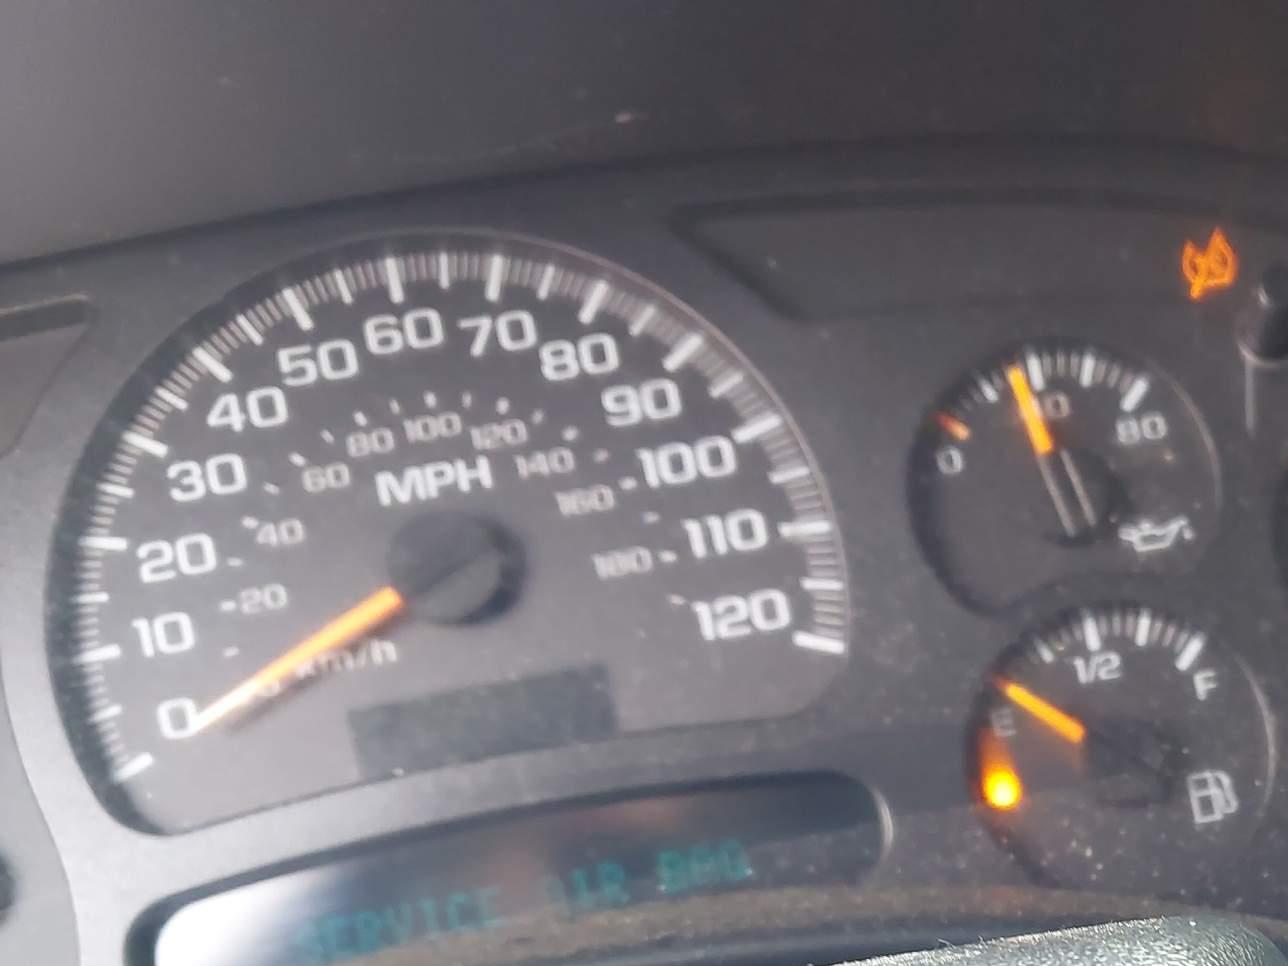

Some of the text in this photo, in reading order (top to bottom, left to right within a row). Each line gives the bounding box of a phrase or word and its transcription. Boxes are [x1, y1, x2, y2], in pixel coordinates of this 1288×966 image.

[363, 307, 445, 355] 60
[458, 309, 538, 357] 70
[277, 339, 359, 387] 50
[538, 332, 620, 382] 80
[206, 385, 289, 433] 40
[600, 377, 683, 427] 90
[347, 426, 395, 458] 80
[404, 411, 462, 443] 100
[470, 418, 528, 451] 120
[1115, 412, 1167, 446] 80
[166, 453, 248, 502] 30
[302, 462, 351, 494] 60
[375, 454, 493, 506] MPH
[515, 445, 575, 479] 140
[636, 434, 737, 489] 100
[936, 444, 965, 475] 0
[256, 517, 305, 547] 40
[680, 507, 769, 559] 110
[136, 532, 217, 583] 20
[239, 582, 288, 615] 20
[691, 587, 792, 641] 120
[131, 611, 195, 657] 10
[1073, 650, 1122, 684] 1/2
[1192, 669, 1218, 700] F
[156, 696, 200, 739] 0
